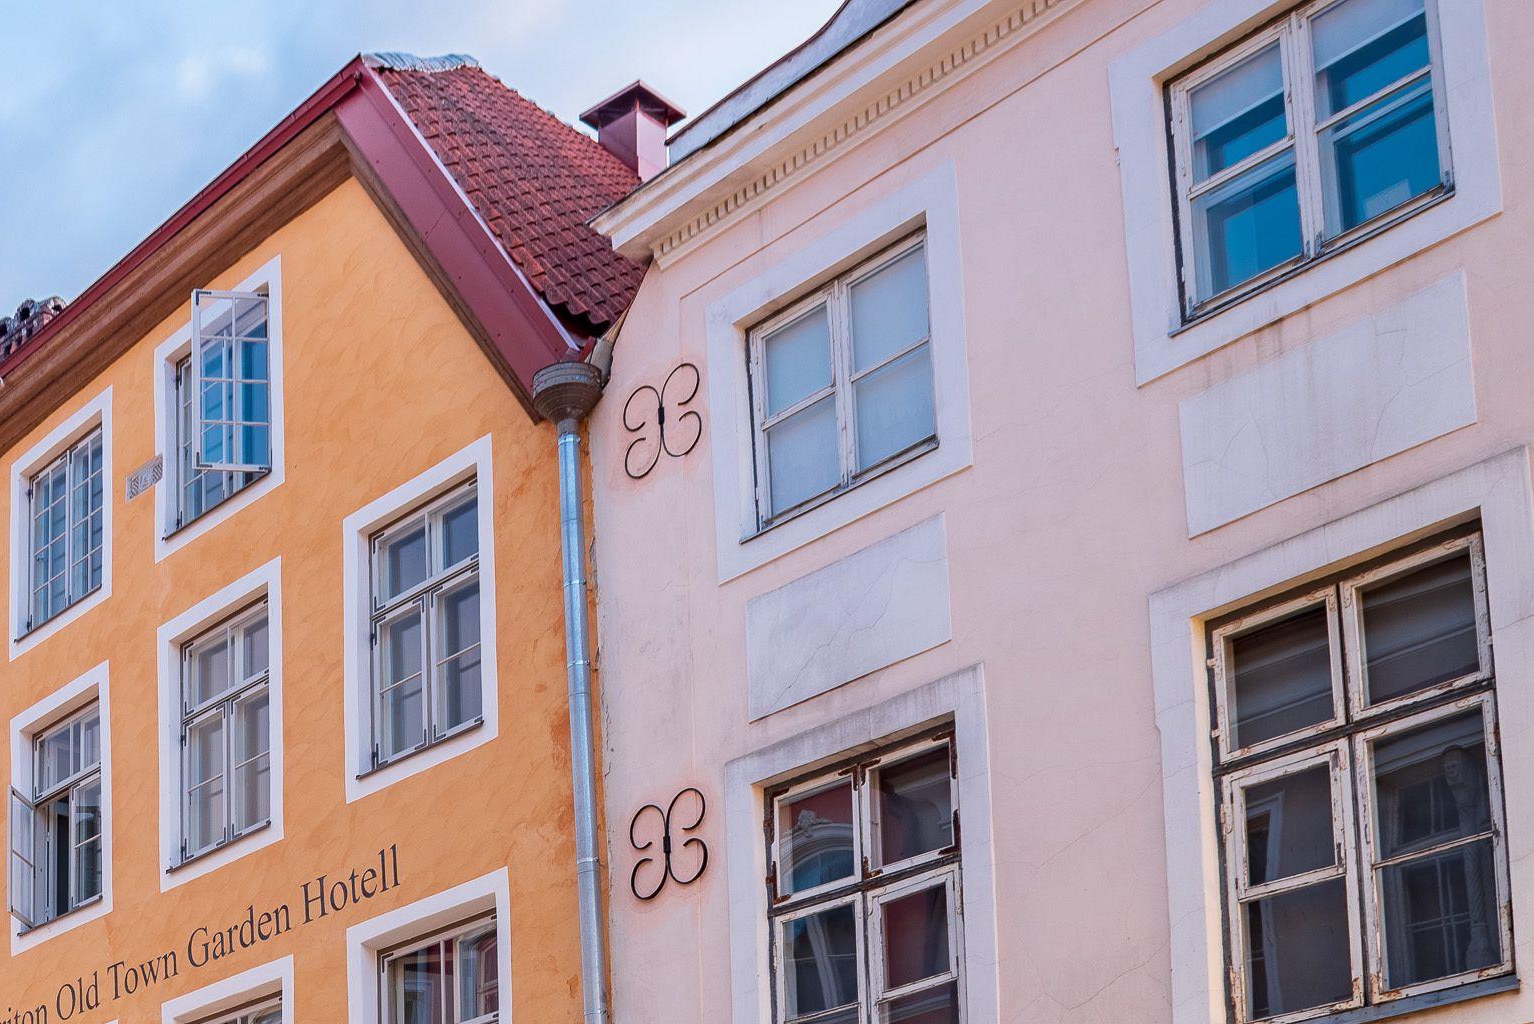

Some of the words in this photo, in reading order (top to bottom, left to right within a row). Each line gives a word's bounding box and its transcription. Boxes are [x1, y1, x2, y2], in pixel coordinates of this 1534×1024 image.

[56, 972, 101, 1021] Old
[107, 949, 179, 1002] Town
[187, 903, 292, 968] Garden
[300, 843, 401, 925] Hotell
